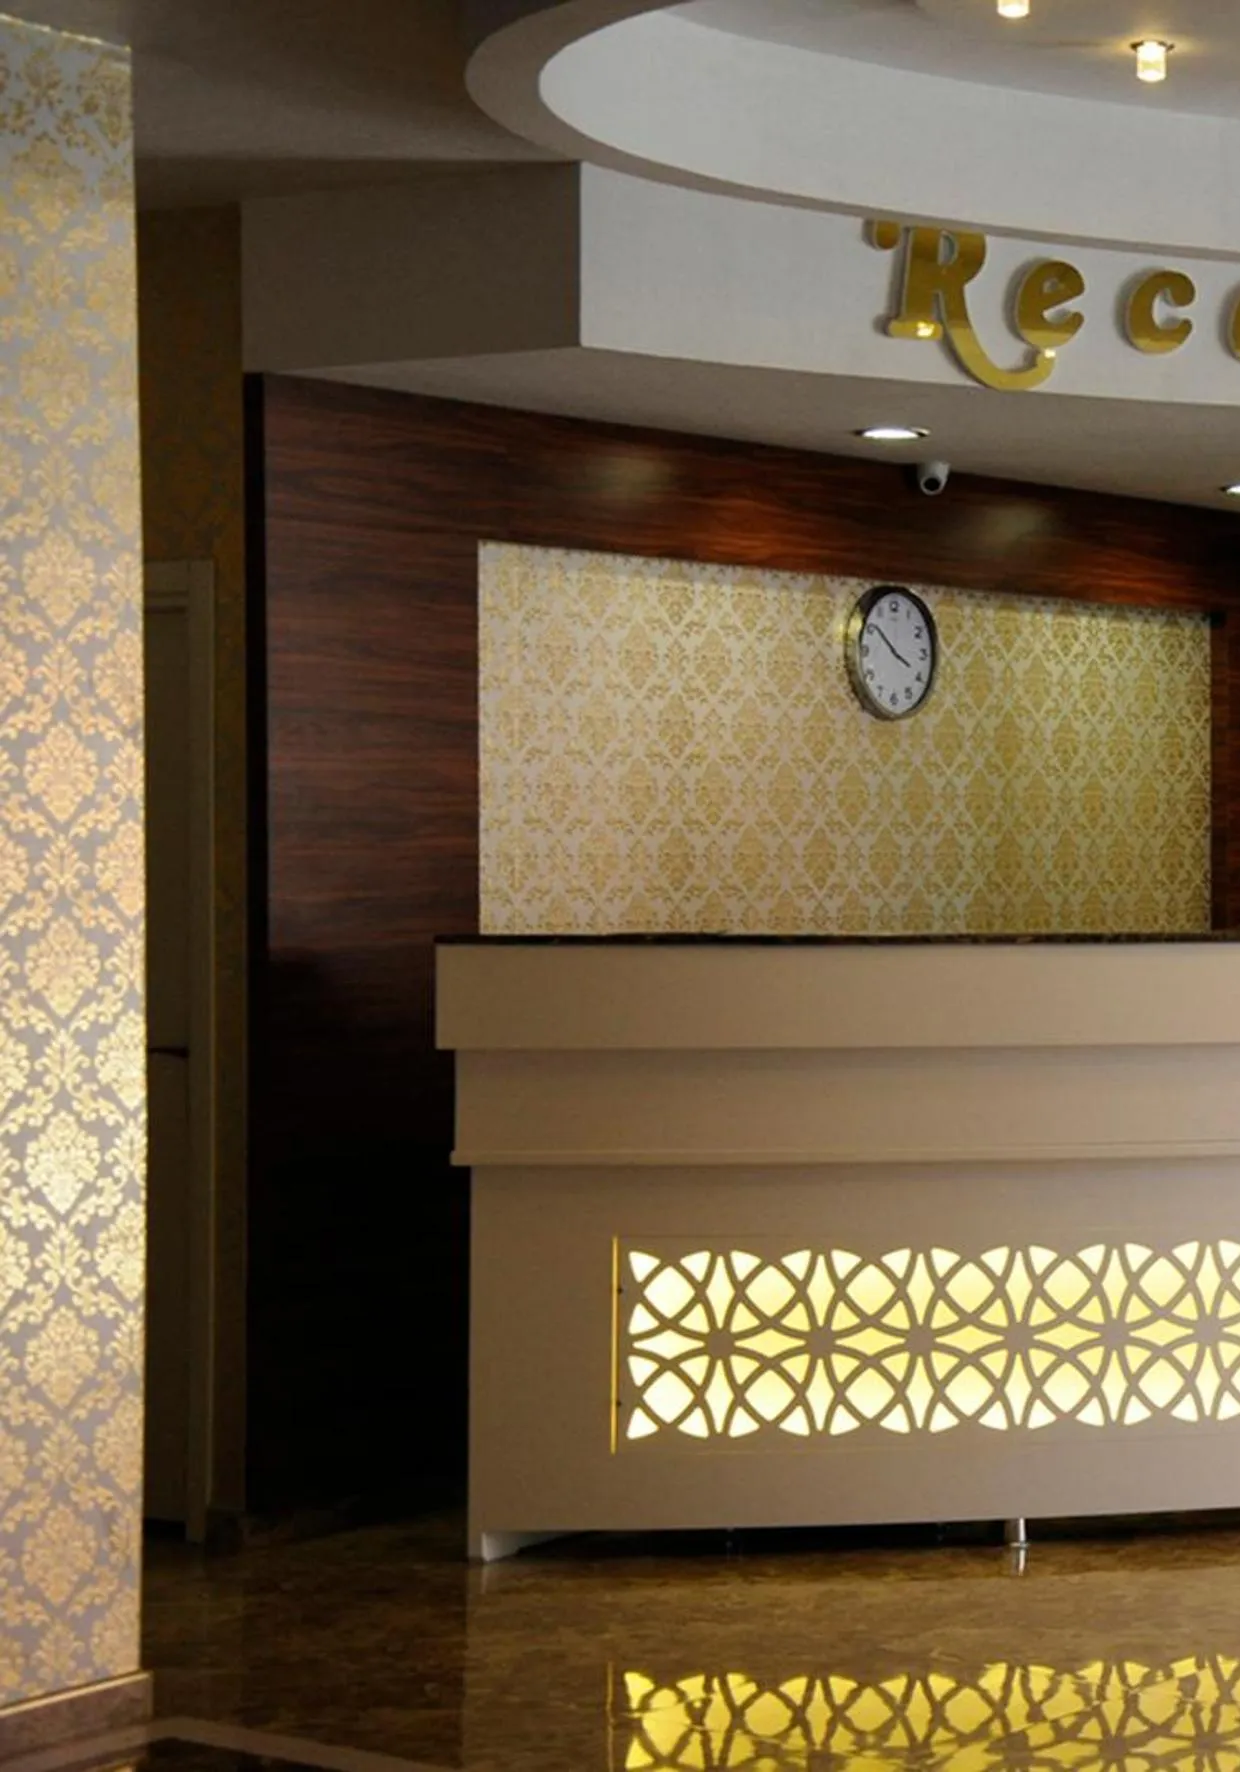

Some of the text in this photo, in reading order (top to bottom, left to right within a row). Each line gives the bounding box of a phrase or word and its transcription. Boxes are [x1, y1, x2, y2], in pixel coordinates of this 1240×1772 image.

[914, 626, 924, 639] 2
[920, 648, 928, 661] 3
[915, 671, 924, 683] 4
[877, 685, 885, 697] 7
[904, 687, 913, 700] 5
[889, 692, 899, 706] 6
